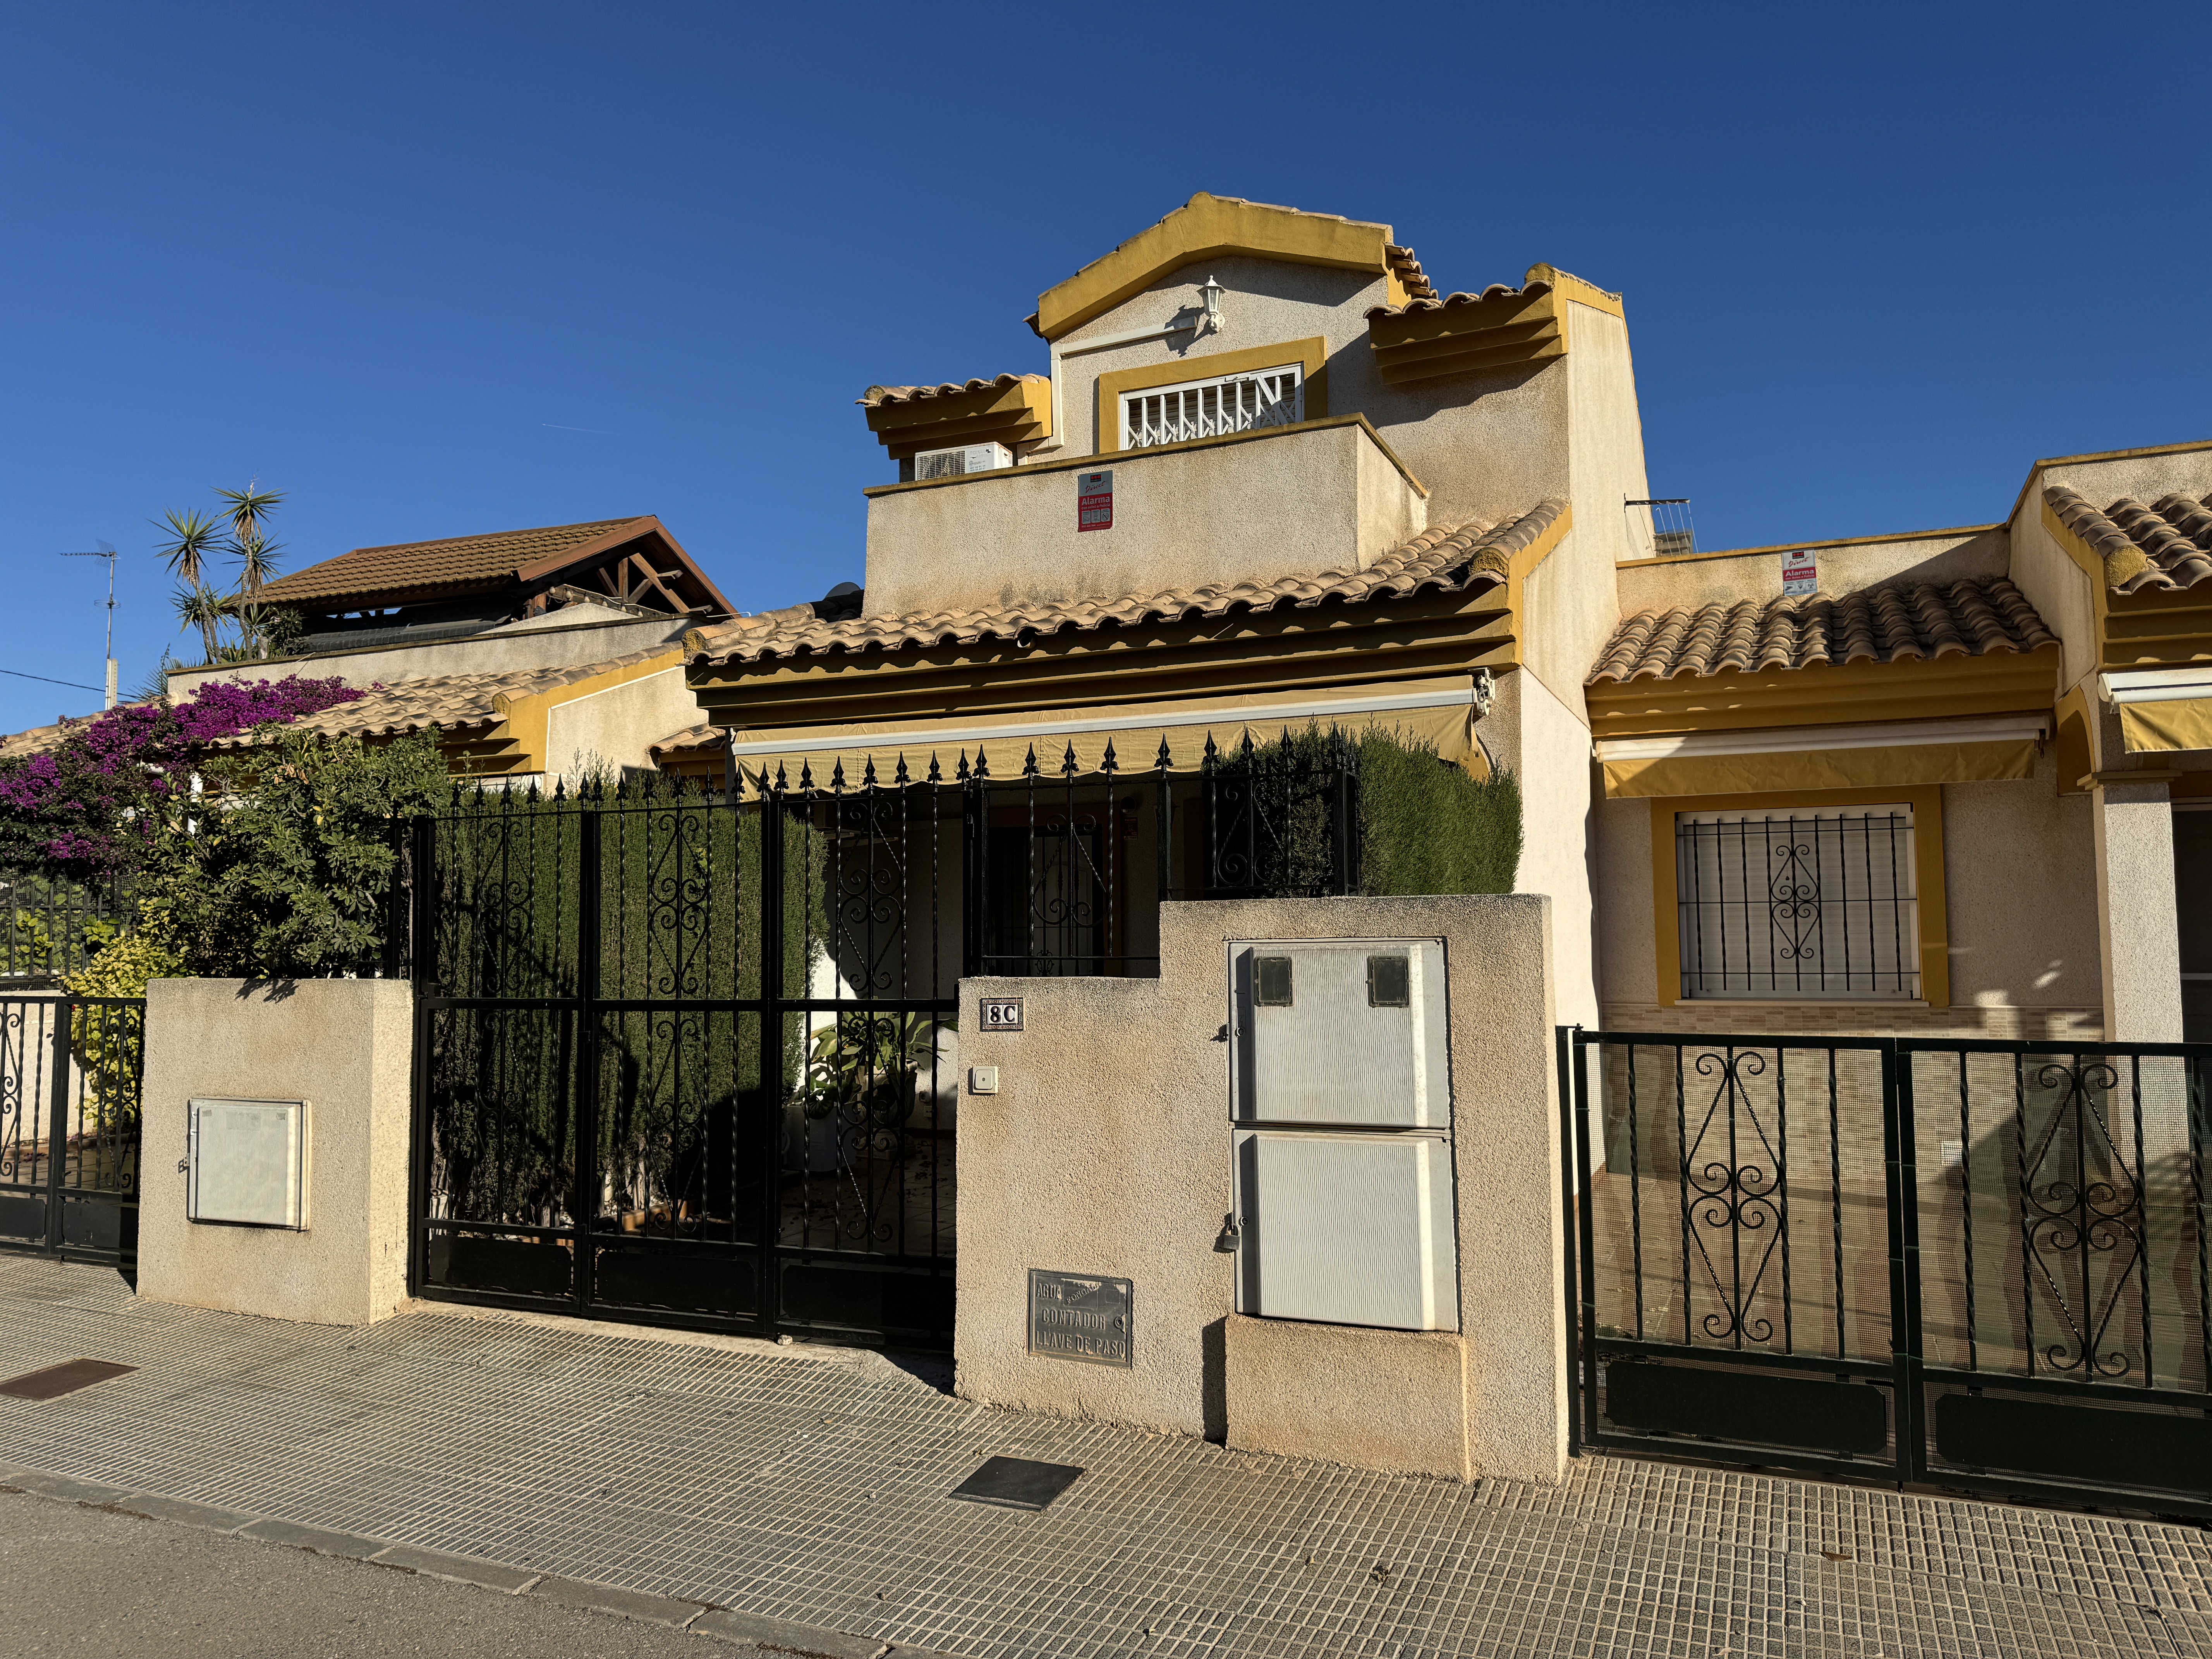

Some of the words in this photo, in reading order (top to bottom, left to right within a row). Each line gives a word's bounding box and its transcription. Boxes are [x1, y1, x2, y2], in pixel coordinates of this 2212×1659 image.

[1082, 496, 1110, 505] Alarma
[990, 1006, 1015, 1023] 8C
[1036, 1283, 1061, 1300] AGUA
[1042, 1308, 1105, 1329] CONTADOR
[1036, 1331, 1072, 1349] LLAVE
[1076, 1335, 1091, 1353] DE
[1095, 1338, 1125, 1357] PASO
